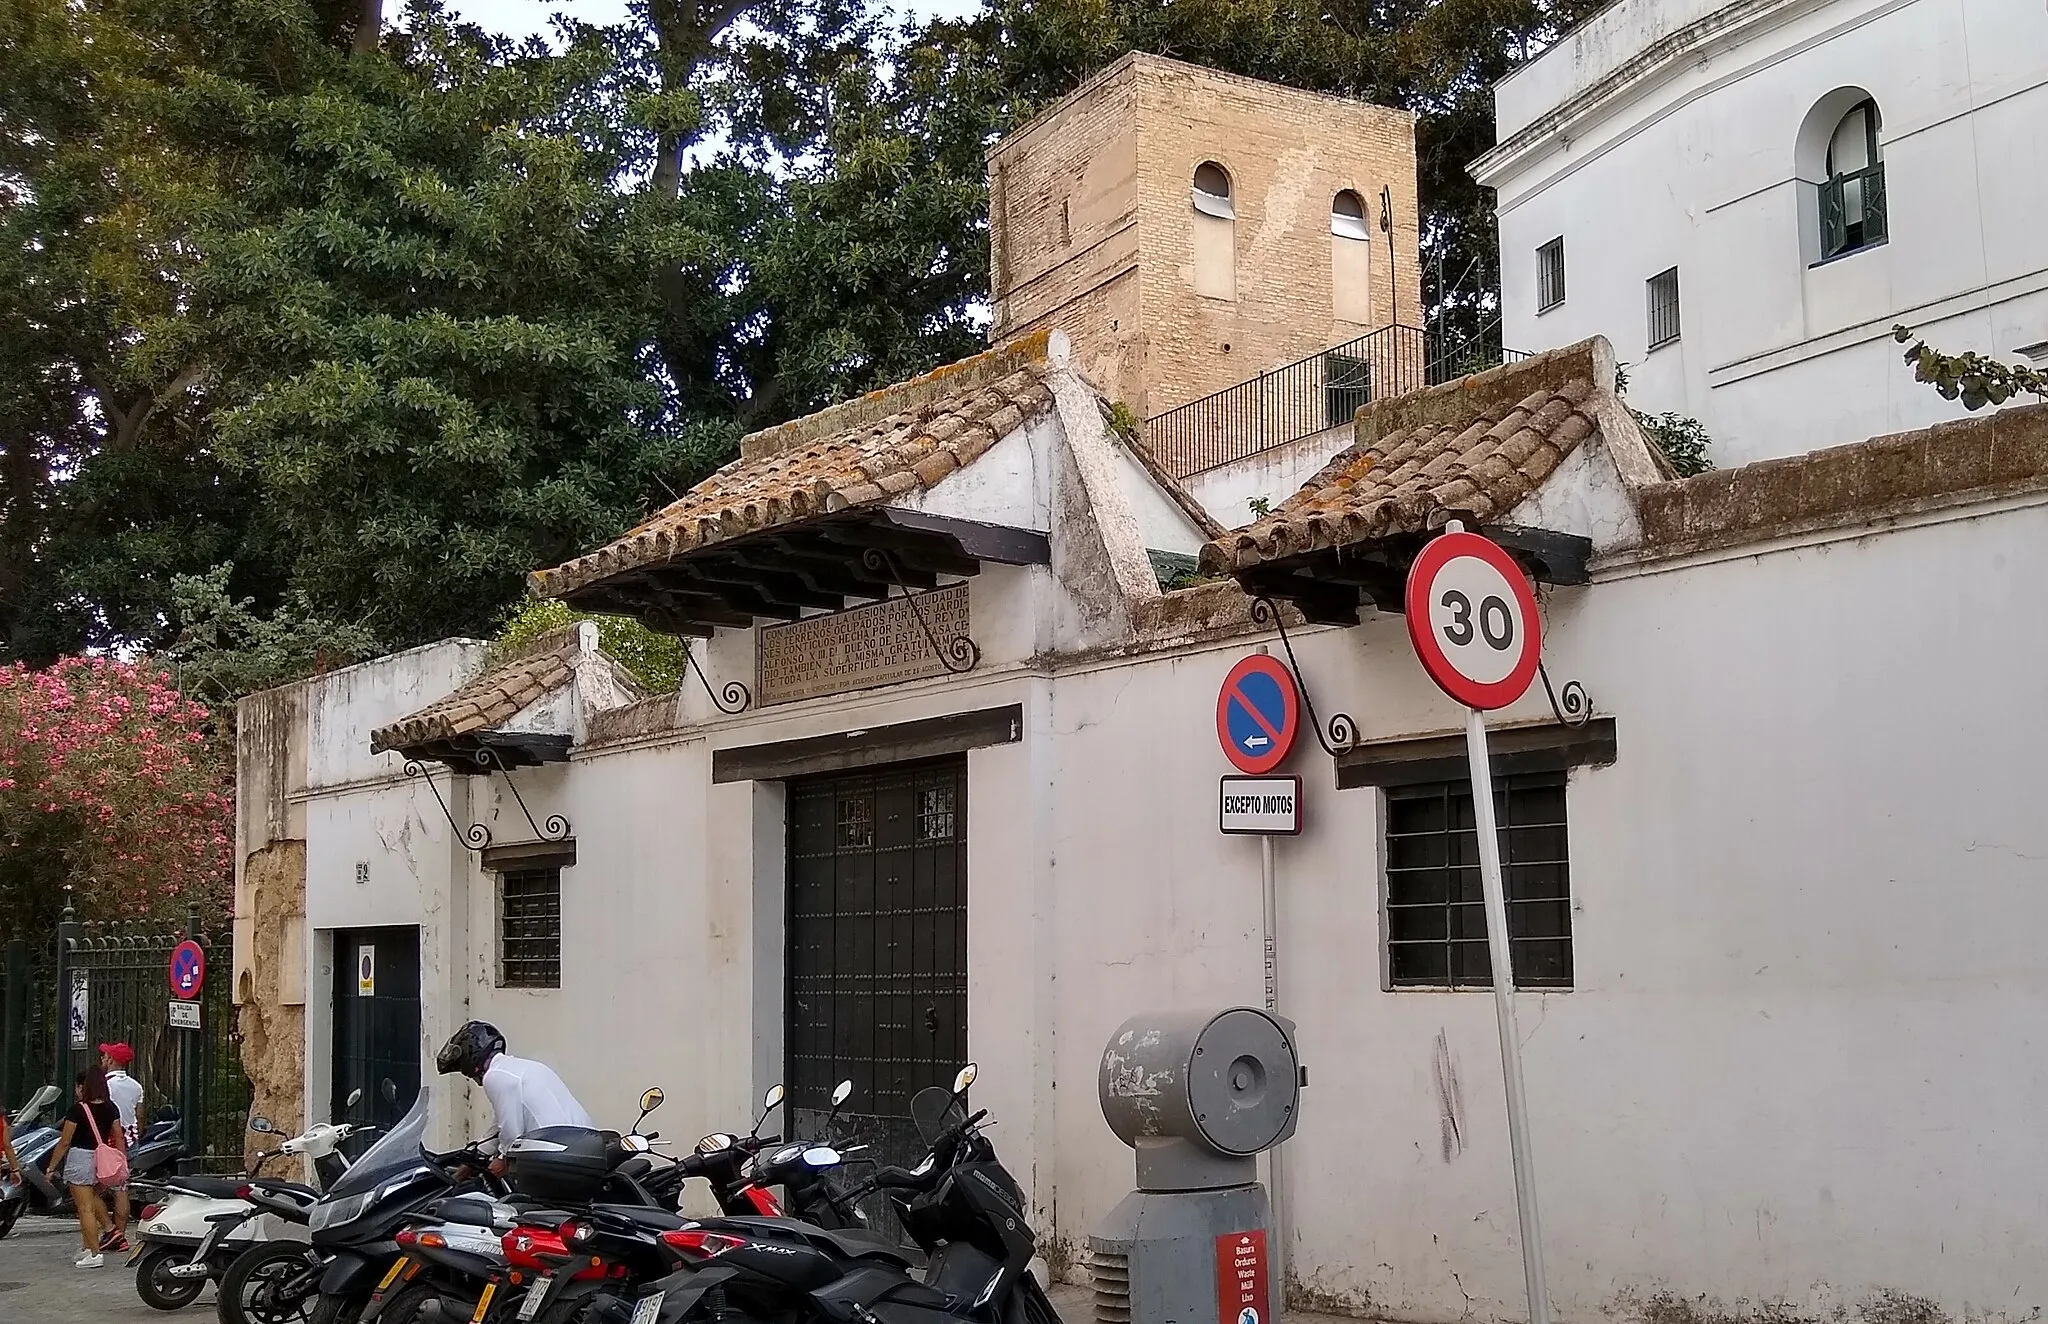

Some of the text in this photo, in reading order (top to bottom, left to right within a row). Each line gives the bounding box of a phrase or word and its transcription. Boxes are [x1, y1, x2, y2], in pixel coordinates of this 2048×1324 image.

[766, 586, 969, 640] CON MOTIVO DE LA CESION A LA CIUDAD DE
[784, 627, 831, 646] TERRENOS
[834, 615, 885, 635] OCUPADOS
[888, 610, 908, 623] POR
[1442, 589, 1514, 651] 30
[764, 648, 780, 659] NES
[839, 629, 869, 644] HECHA
[873, 624, 892, 637] POR
[935, 610, 954, 624] REY
[764, 654, 804, 671] ALFONSO
[845, 637, 876, 654] DUEÑO
[879, 635, 891, 647] DE
[895, 629, 921, 644] ESTA
[764, 669, 779, 680] DIO
[783, 660, 822, 677] TAMBIEN
[856, 647, 884, 662] MISMA
[765, 679, 775, 689] TE
[778, 674, 802, 686] TODA
[806, 670, 819, 681] LA
[824, 658, 879, 678] SUPERFICIE
[885, 655, 897, 666] DE
[904, 648, 930, 662] ESTA
[1224, 795, 1293, 815] EXCEPTO MOTOS
[1234, 1257, 1257, 1267] Ordures
[1236, 1246, 1255, 1255] Basura
[1238, 1269, 1255, 1279] Waste
